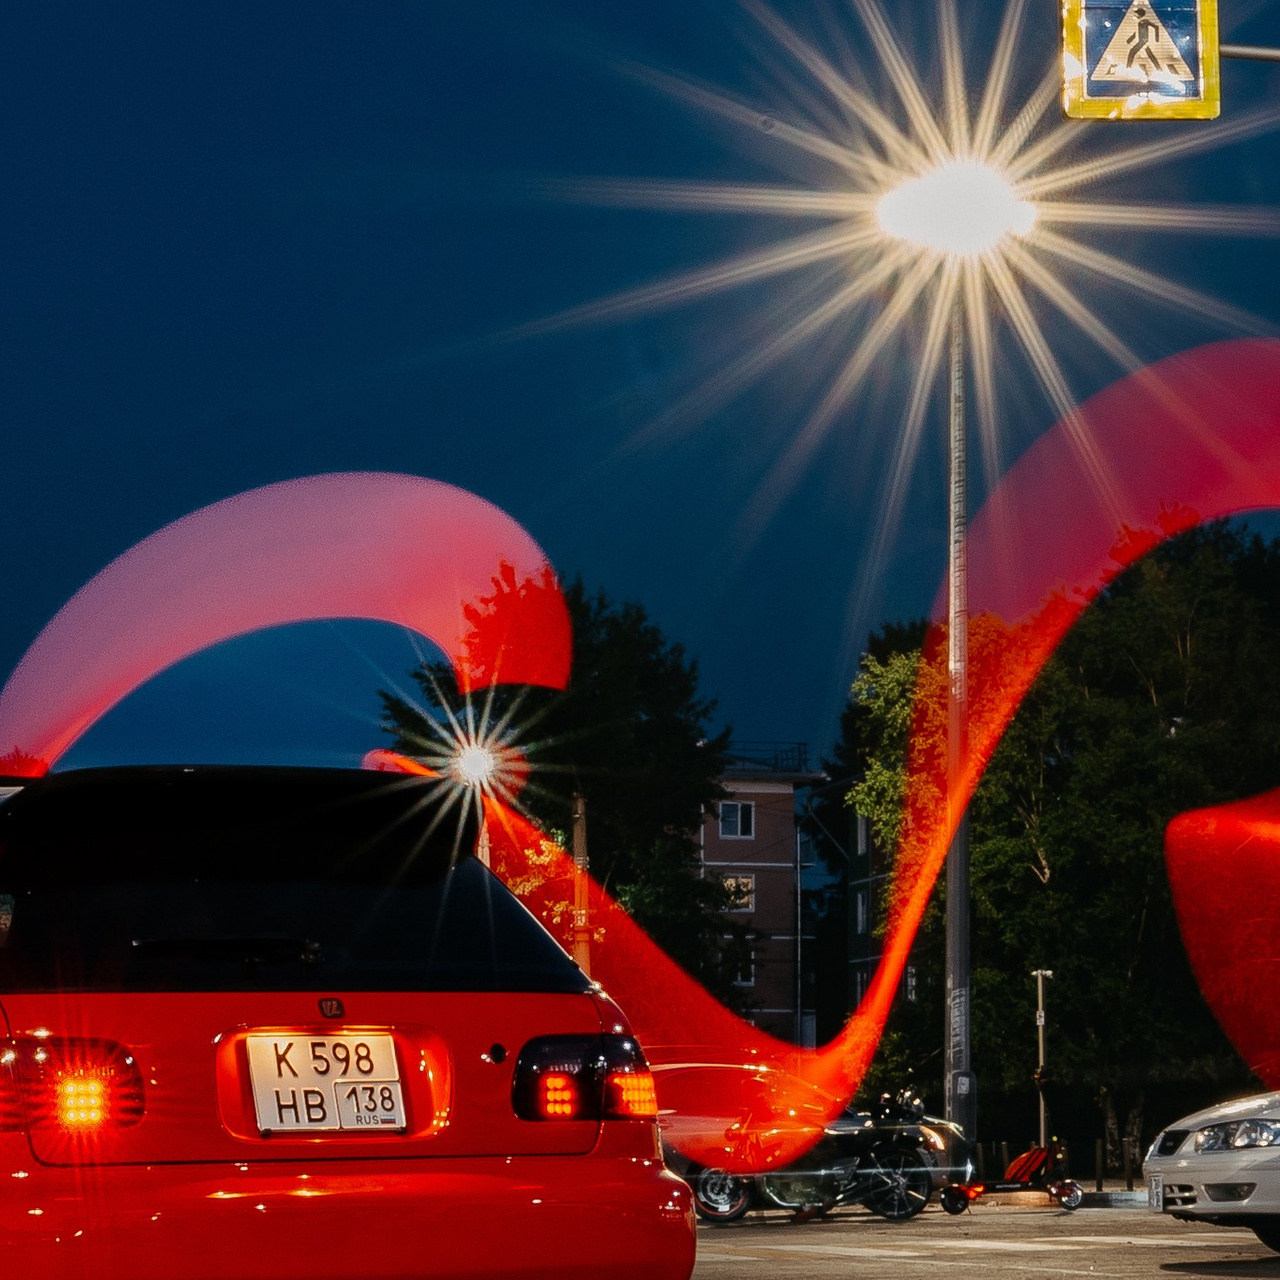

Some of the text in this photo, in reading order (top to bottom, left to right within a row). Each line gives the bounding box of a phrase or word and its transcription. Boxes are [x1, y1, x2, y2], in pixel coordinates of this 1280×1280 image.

[310, 1041, 374, 1076] 598
[346, 1086, 395, 1113] 138
[356, 1115, 380, 1125] RUS
